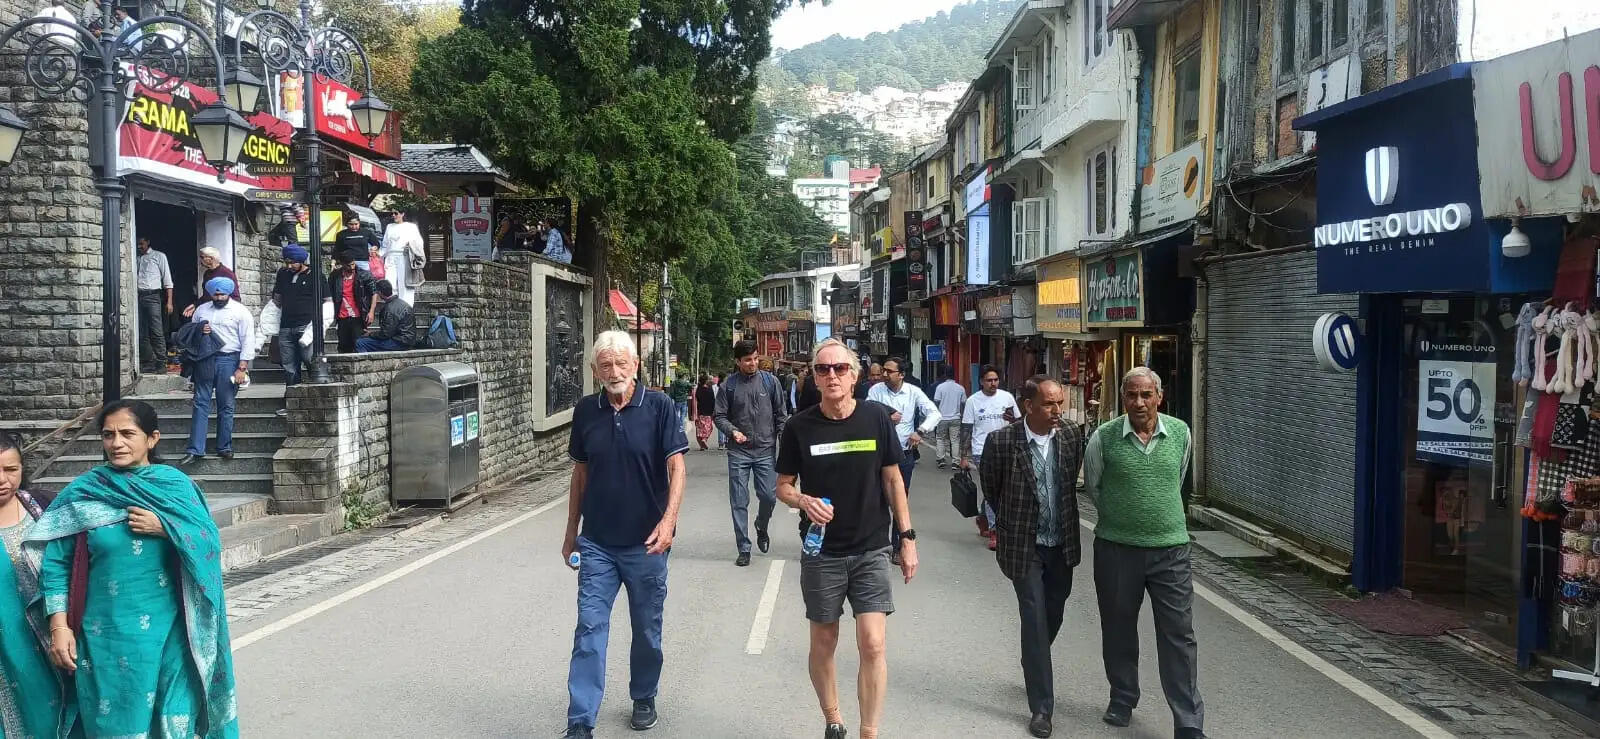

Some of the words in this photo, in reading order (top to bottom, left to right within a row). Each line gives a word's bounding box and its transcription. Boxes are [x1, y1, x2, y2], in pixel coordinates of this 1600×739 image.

[129, 97, 189, 136] RAMA
[1518, 64, 1600, 181] U
[184, 146, 202, 165] THE
[275, 191, 294, 200] CHURCH
[1314, 212, 1404, 248] NUMERO
[1405, 203, 1470, 236] UNO
[1344, 247, 1360, 256] THE
[1368, 242, 1393, 254] REAL
[1400, 238, 1435, 251] DENIM
[1431, 343, 1472, 352] NUMERO
[1474, 345, 1496, 353] UNO
[1428, 369, 1453, 377] UPTO
[1426, 377, 1486, 424] 50%
